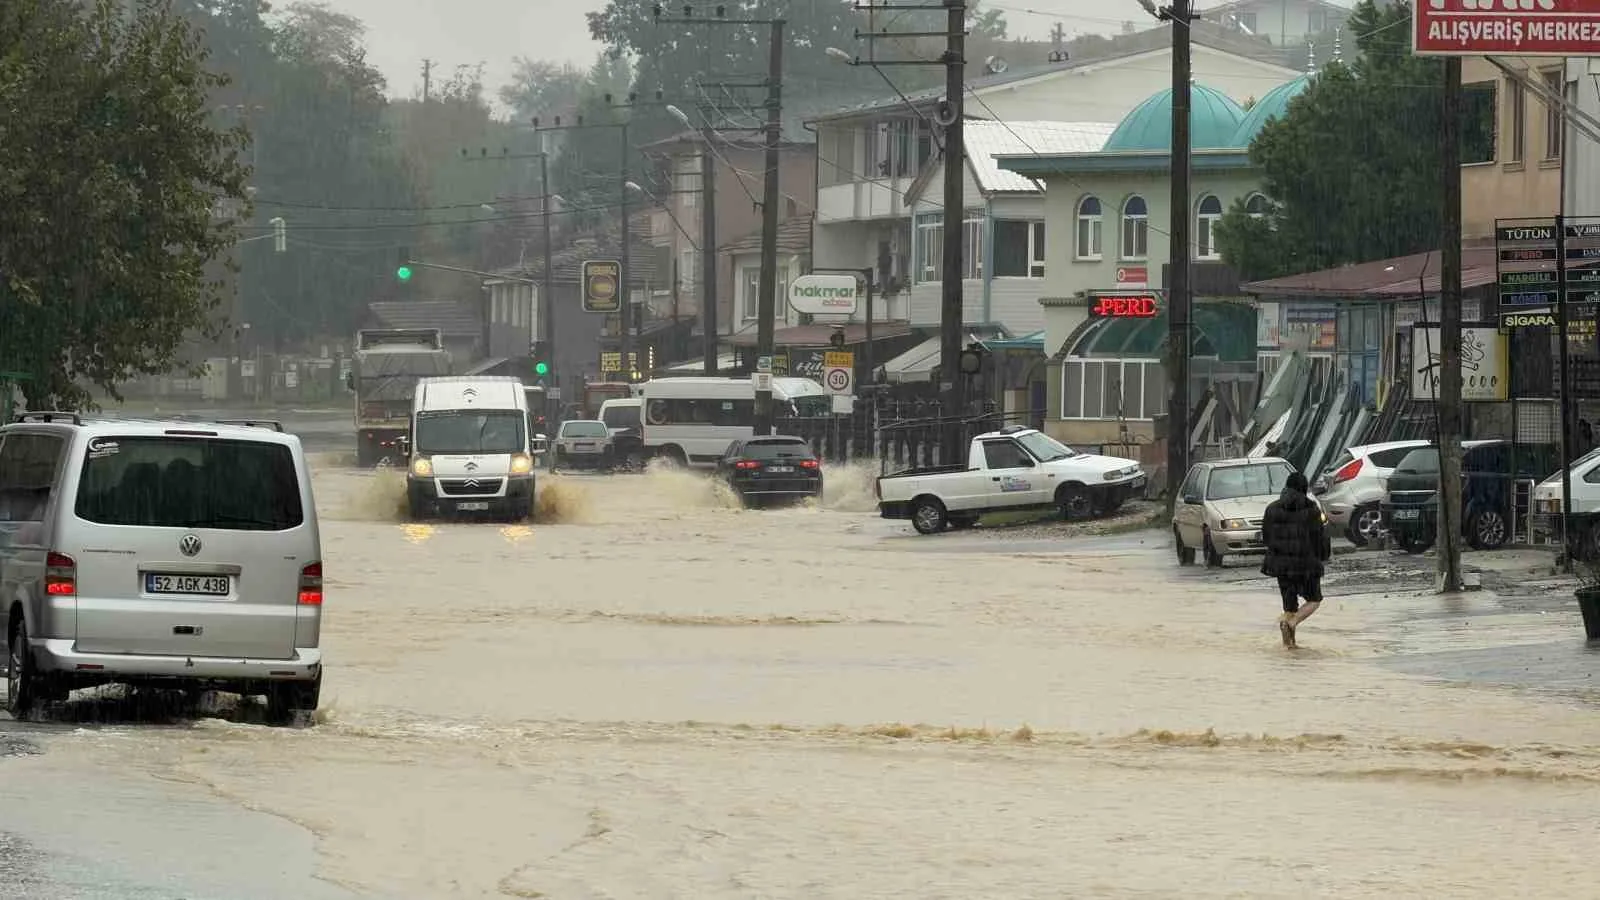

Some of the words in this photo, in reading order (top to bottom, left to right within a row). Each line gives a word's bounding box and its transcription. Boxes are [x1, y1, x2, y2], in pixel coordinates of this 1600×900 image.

[1429, 18, 1523, 46] ALIŞVERİŞ
[1528, 22, 1600, 41] MERKEZ
[794, 285, 855, 297] hakmar
[1505, 315, 1556, 327] SİGARA
[831, 375, 845, 385] 30
[155, 576, 172, 591] 52
[176, 577, 200, 591] AGK
[203, 580, 227, 592] 438
